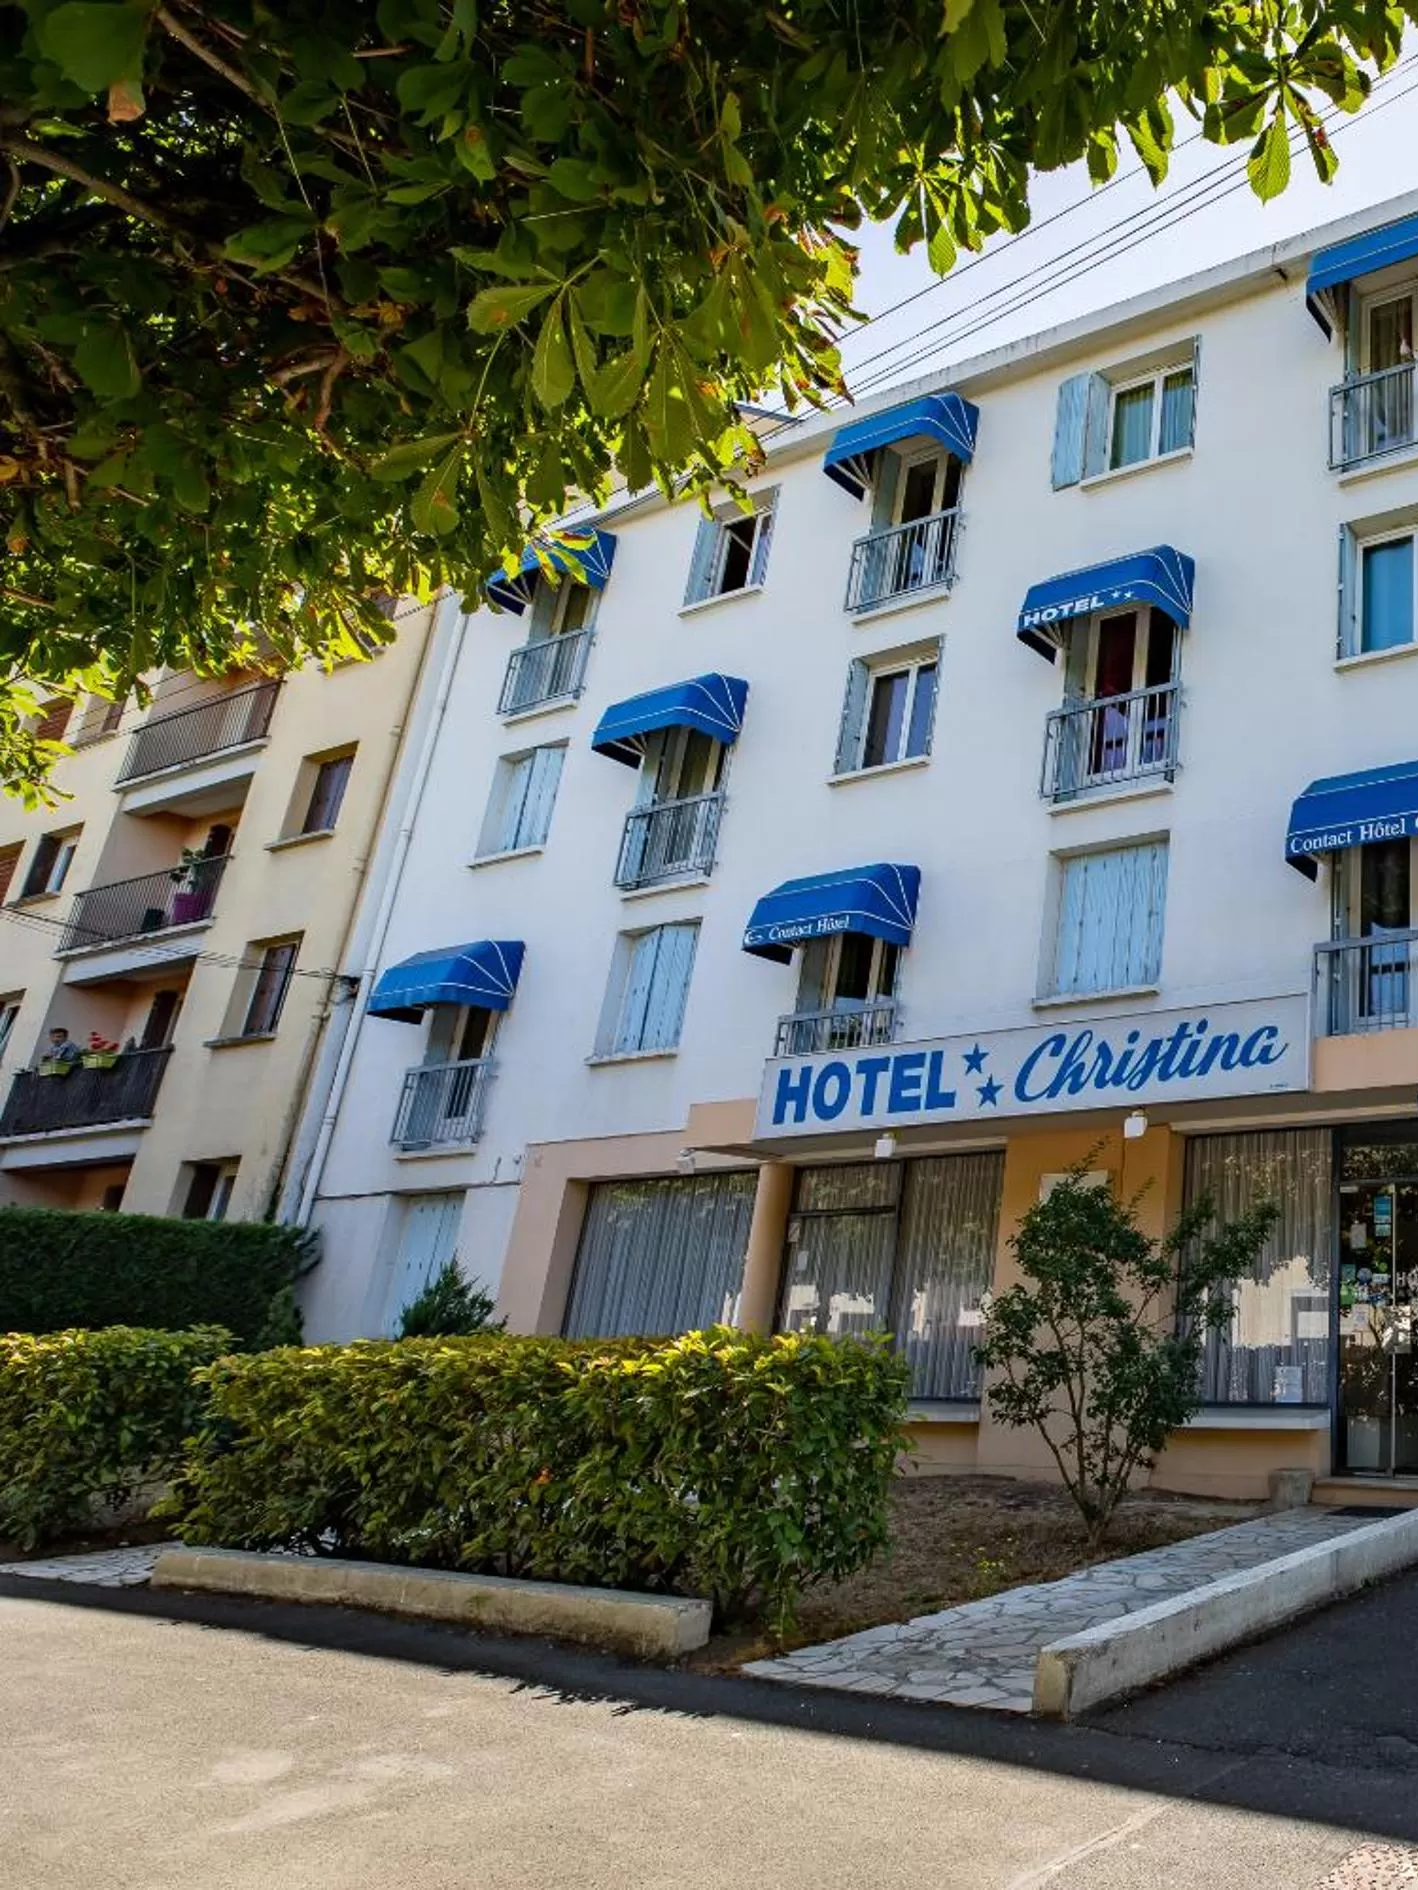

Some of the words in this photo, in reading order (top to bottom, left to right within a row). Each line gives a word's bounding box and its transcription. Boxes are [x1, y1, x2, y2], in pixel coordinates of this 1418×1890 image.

[1024, 596, 1104, 627] HOTEL
[1290, 829, 1353, 854] Contact
[1359, 818, 1406, 842] Hôtel
[771, 1049, 956, 1125] HOTEL
[1014, 1018, 1290, 1103] Christina
